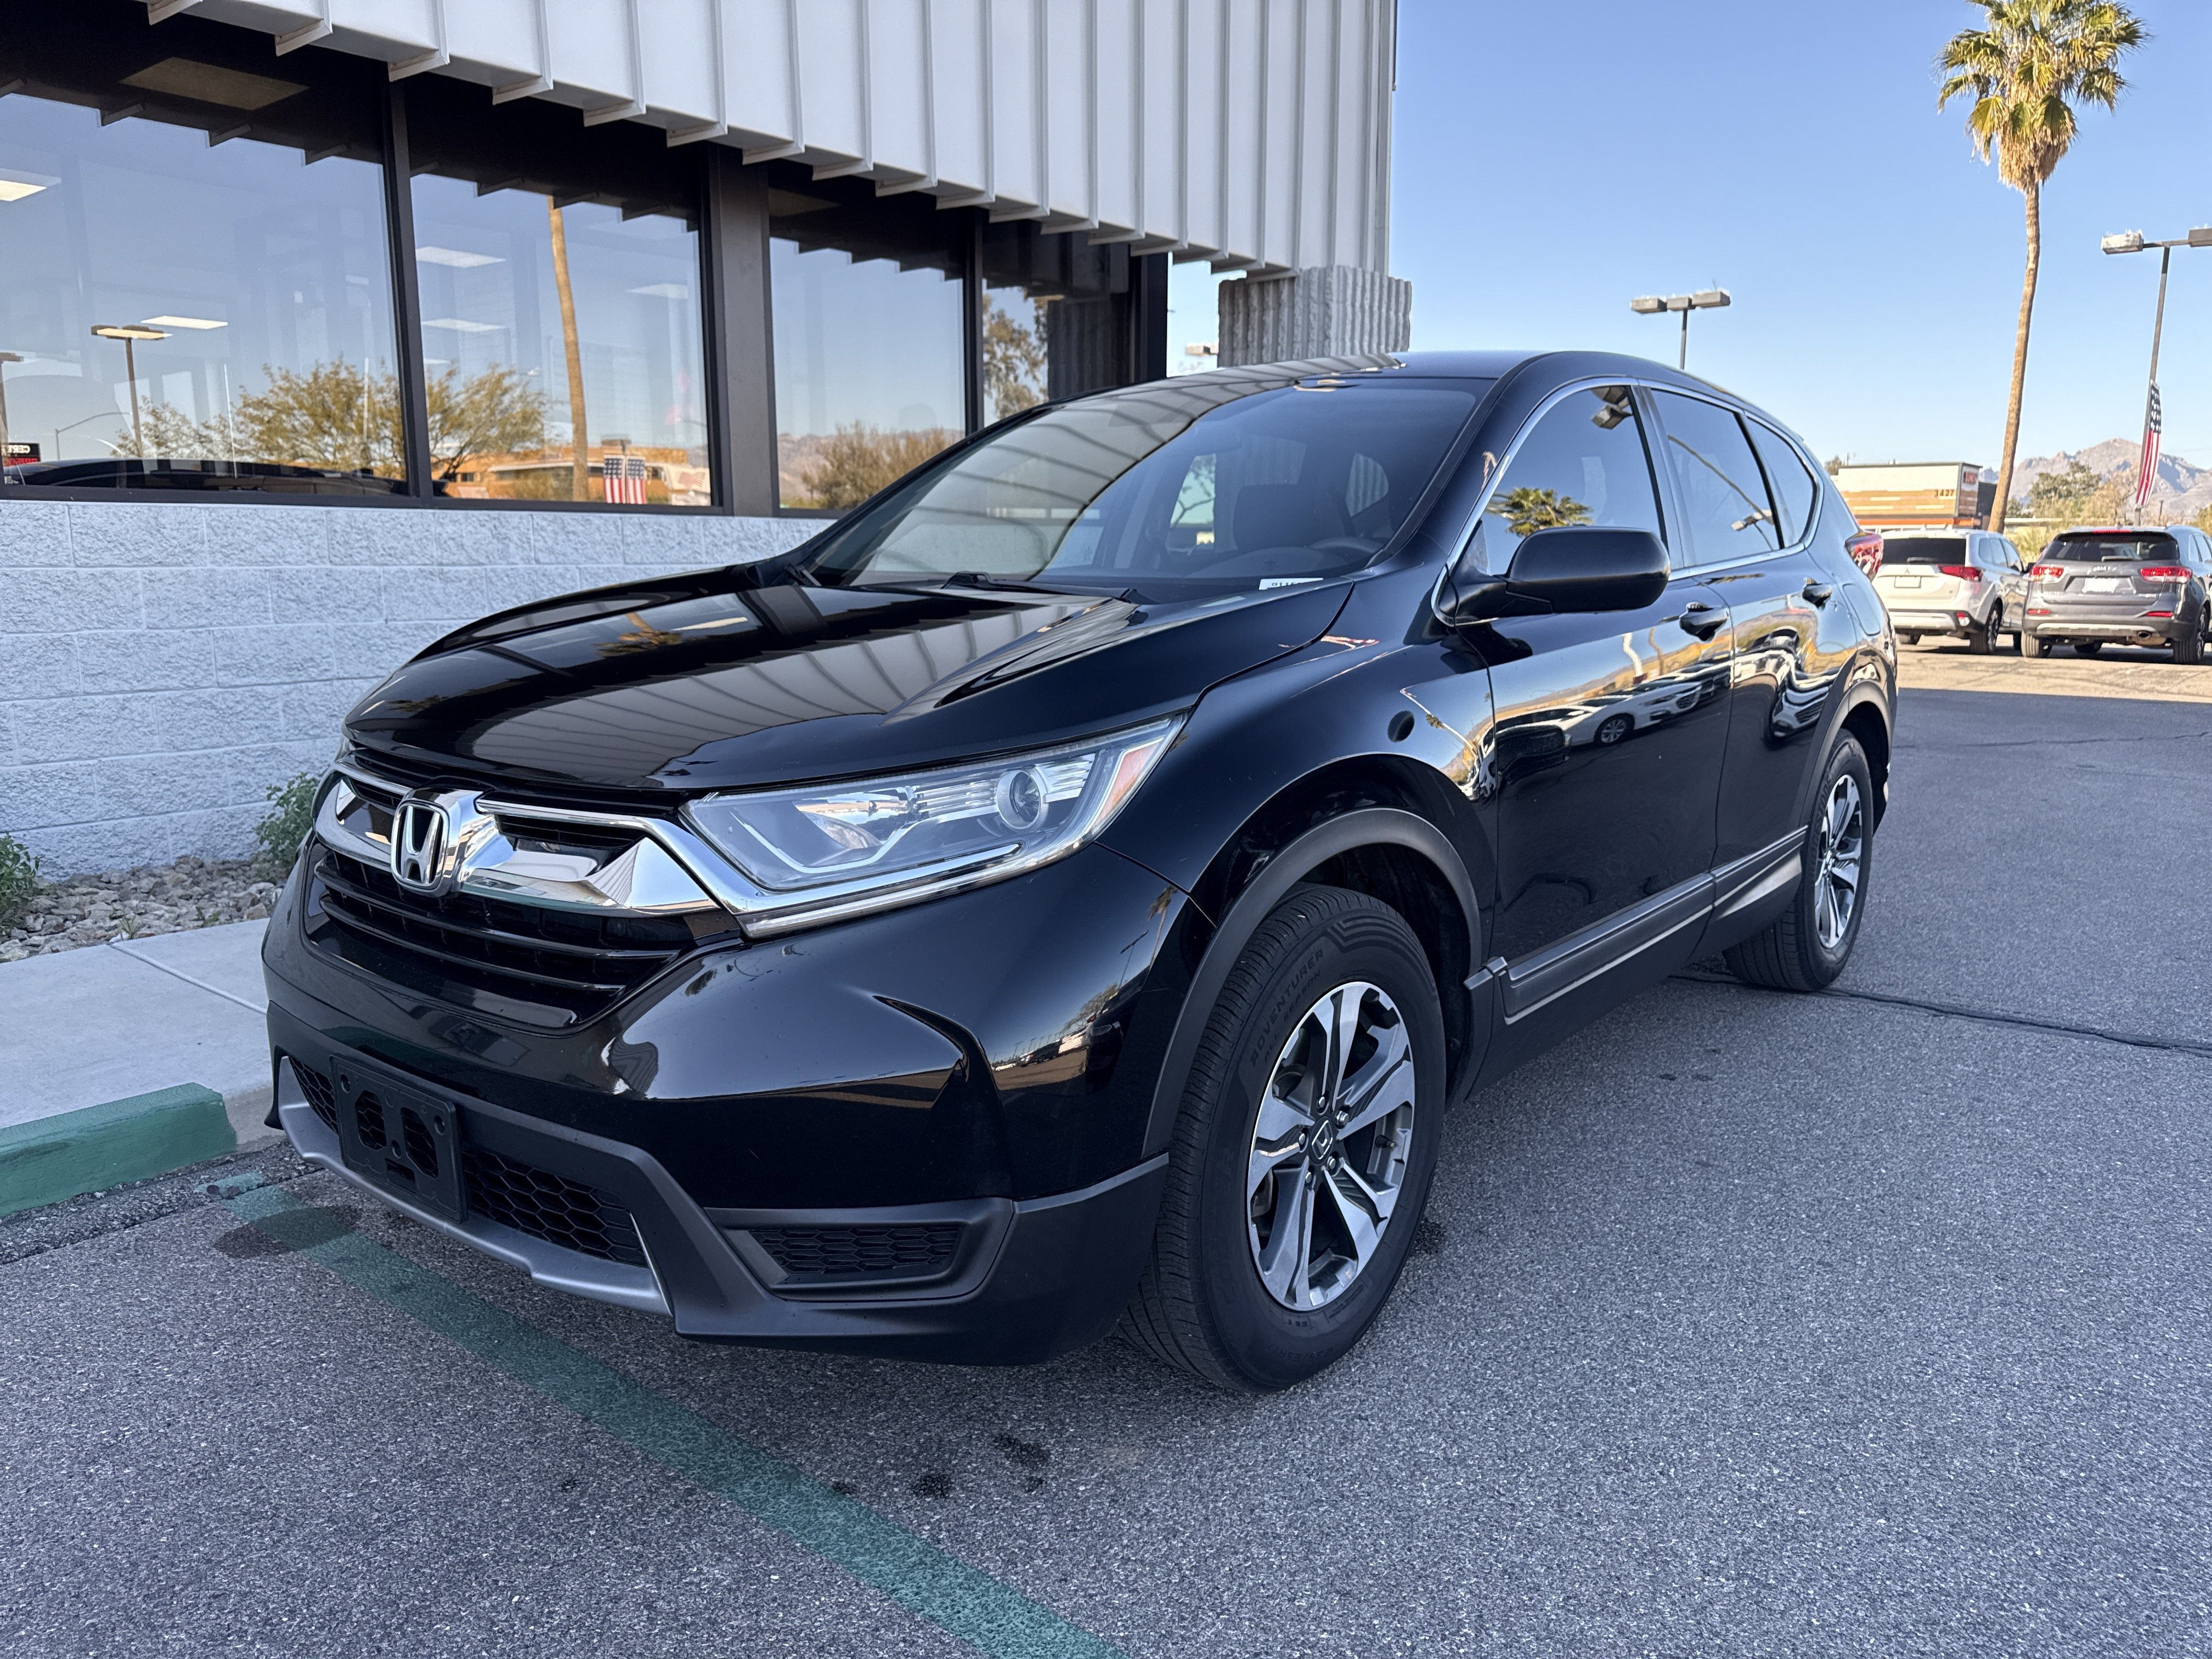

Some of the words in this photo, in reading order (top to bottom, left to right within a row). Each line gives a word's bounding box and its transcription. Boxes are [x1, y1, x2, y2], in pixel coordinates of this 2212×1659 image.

[1249, 947, 1324, 1068] ADVENTURER
[1264, 1032, 1280, 1063] ALL
[1283, 969, 1321, 1023] SEASON
